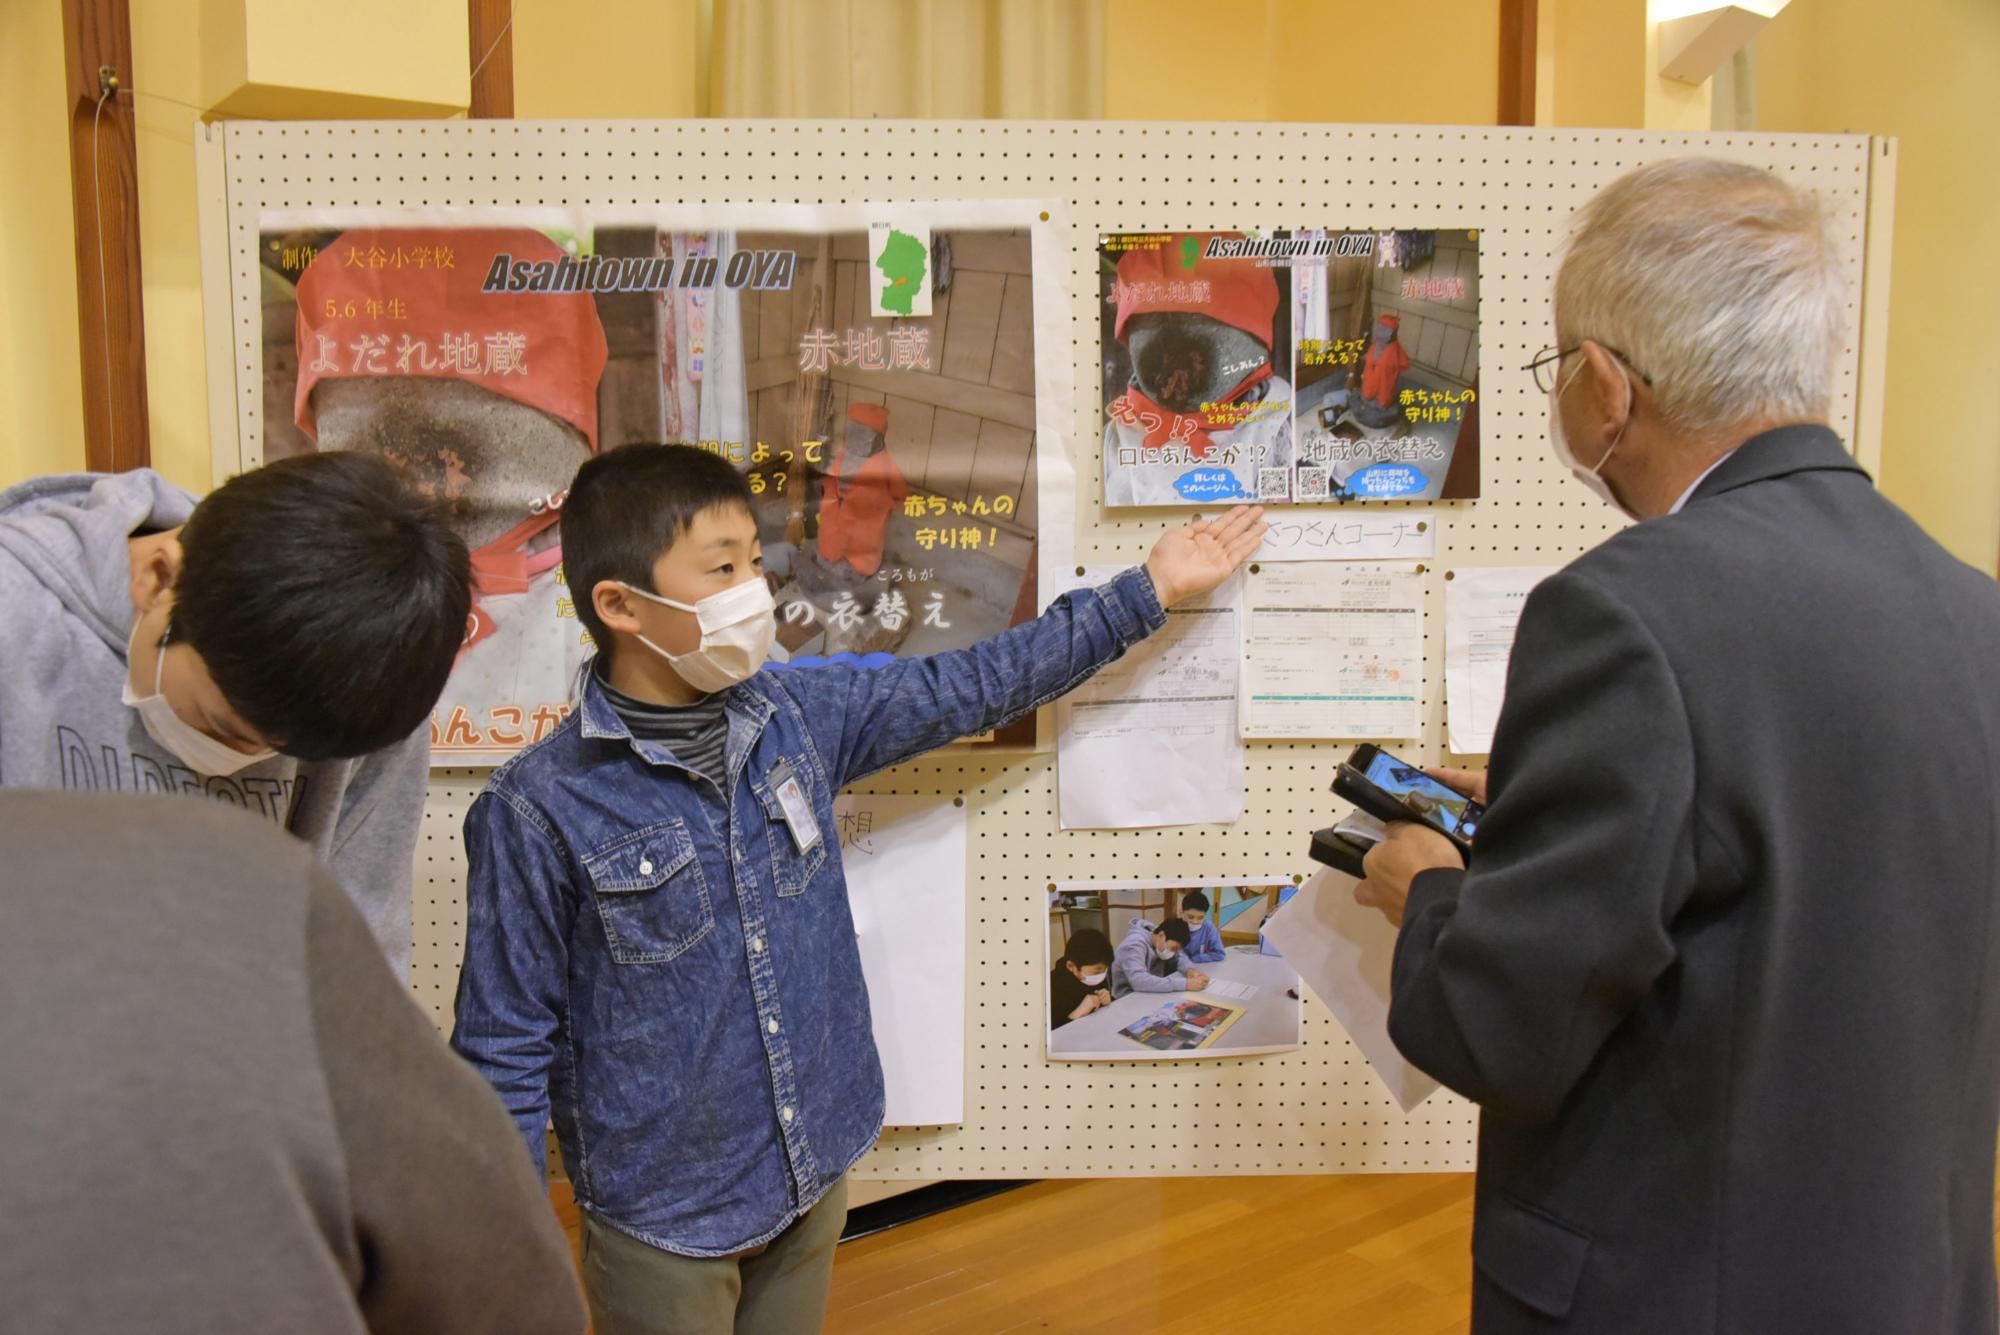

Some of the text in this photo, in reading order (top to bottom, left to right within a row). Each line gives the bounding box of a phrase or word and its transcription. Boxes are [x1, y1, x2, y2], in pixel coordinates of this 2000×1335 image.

[281, 246, 455, 270] 制作 大谷小学校
[1203, 233, 1376, 260] Asahitown in OYA
[481, 248, 797, 294] Asahitown in OYA
[1105, 281, 1212, 304] よだれ地蔵
[1400, 277, 1465, 300] 赤地蔵
[309, 331, 528, 376] よだれ地蔵
[799, 327, 931, 372] 赤地蔵
[1399, 389, 1476, 405] 赤ちゃんの
[679, 440, 823, 463] 期によって
[1304, 437, 1445, 463] 地蔵の衣替え
[528, 489, 569, 516] こし
[903, 494, 1014, 518] 赤ちゃんの
[876, 568, 934, 582] ころもが
[837, 810, 873, 855] 想
